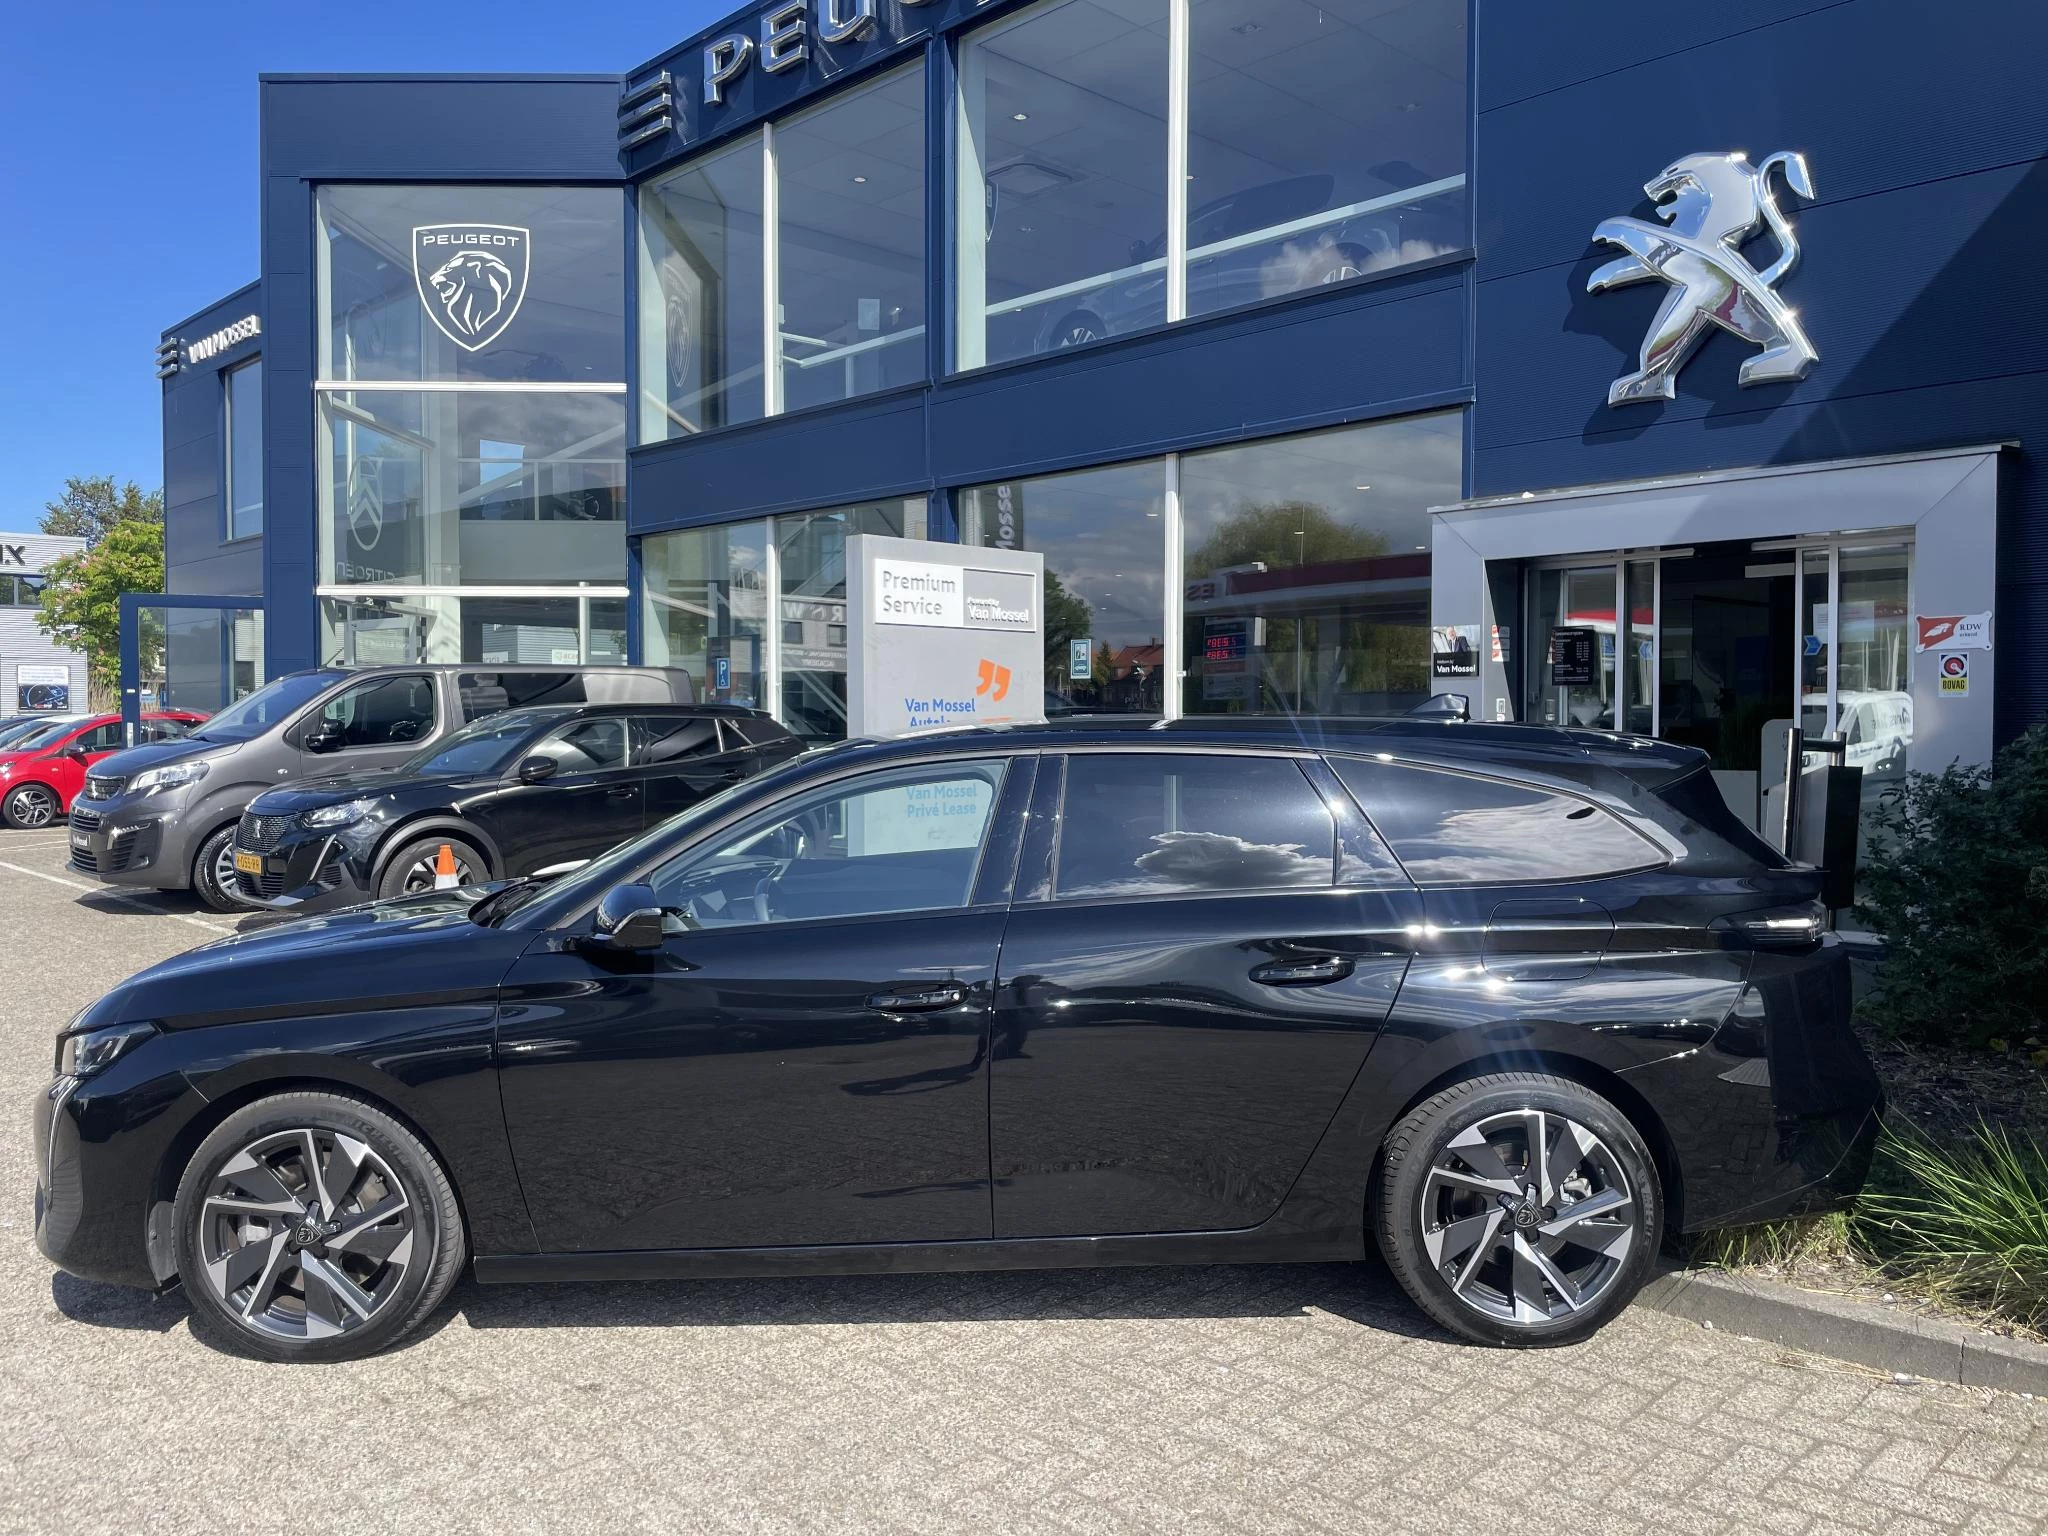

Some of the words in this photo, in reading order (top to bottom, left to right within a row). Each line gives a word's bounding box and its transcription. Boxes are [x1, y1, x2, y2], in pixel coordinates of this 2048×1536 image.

[703, 0, 935, 104] PEU
[423, 234, 519, 246] PEUGEOT
[212, 314, 262, 351] MOSSEL
[883, 570, 956, 593] Premium
[883, 594, 943, 616] Service
[968, 605, 989, 622] Van
[991, 607, 1029, 624] Mossel
[1437, 665, 1450, 673] Van
[1451, 664, 1476, 673] Mossel
[905, 698, 929, 712] Van
[932, 698, 975, 712] Mossel
[906, 785, 934, 800] Van
[934, 783, 977, 799] Mossel
[907, 803, 939, 817] Privé
[943, 803, 976, 814] Lease
